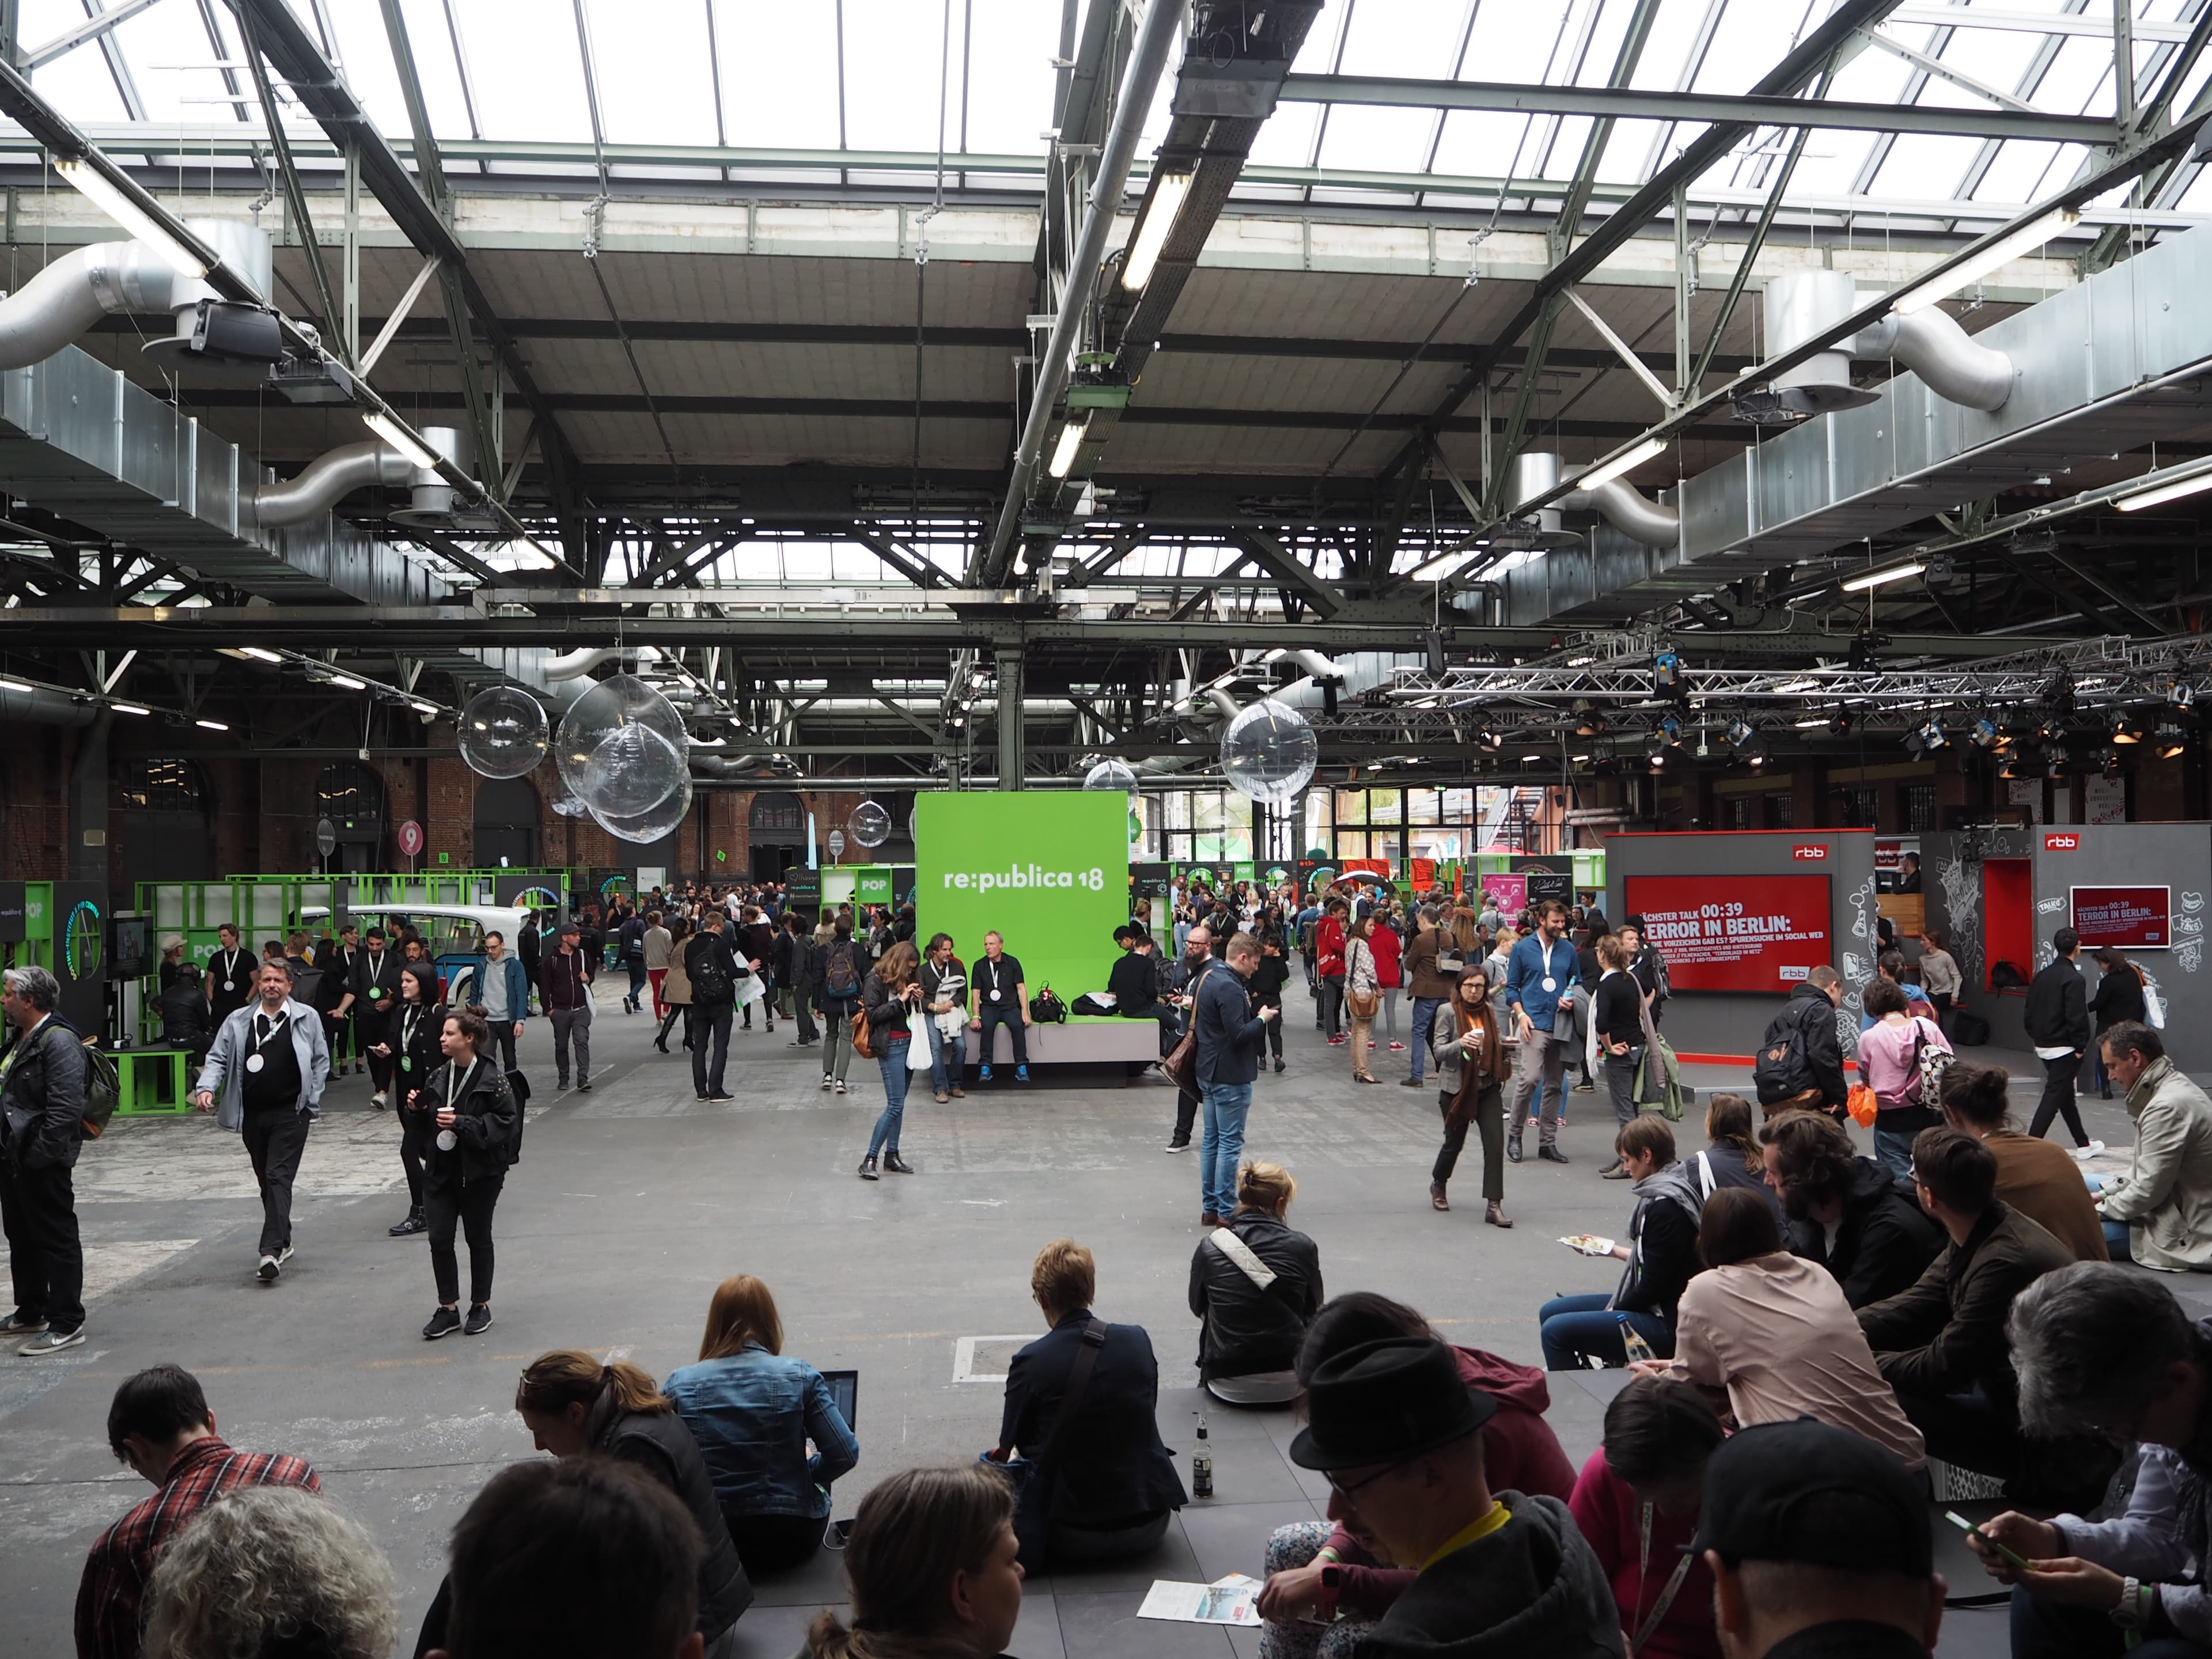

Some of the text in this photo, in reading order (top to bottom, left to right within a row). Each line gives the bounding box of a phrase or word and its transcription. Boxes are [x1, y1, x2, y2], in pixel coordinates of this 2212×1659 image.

[406, 828, 416, 848] 9
[2047, 836, 2075, 847] rbb
[1796, 847, 1824, 857] rbb
[944, 863, 1104, 893] re:publica 18
[862, 880, 887, 891] POP
[1641, 902, 1743, 922] ÄCHSTER TALK 00:39
[2109, 901, 2129, 909] 00:39
[2078, 907, 2152, 921] TERROR IN BERLIN:
[1644, 915, 1791, 940] ERROR IN BERLIN:
[1664, 937, 1700, 948] VORZEICHEN
[1729, 934, 1775, 944] SPURENSUCHE
[1785, 932, 1808, 940] SOCIAL
[194, 944, 225, 959] PO
[1782, 969, 1806, 978] rbb
